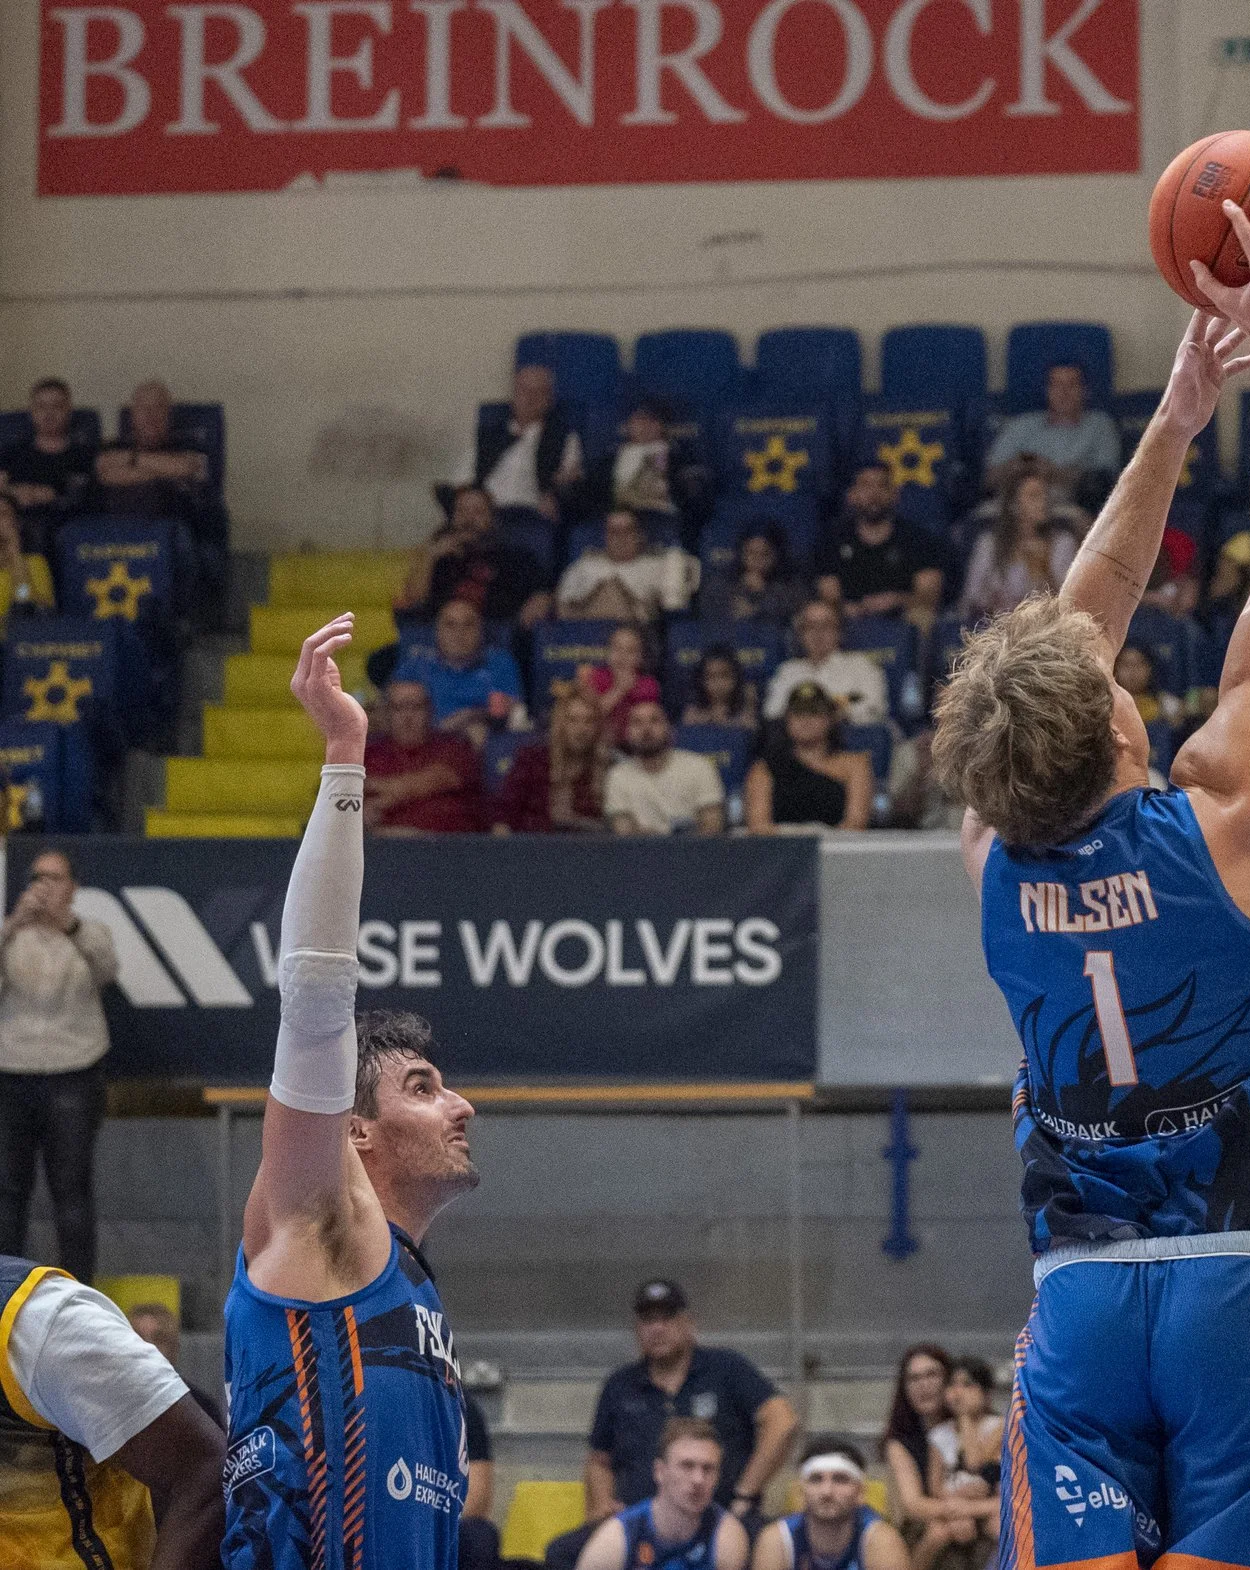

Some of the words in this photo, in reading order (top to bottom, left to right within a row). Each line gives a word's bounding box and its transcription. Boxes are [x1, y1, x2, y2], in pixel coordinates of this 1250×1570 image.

[46, 0, 1130, 138] BREINROCK
[459, 917, 782, 987] WOLVES
[1019, 870, 1159, 933] NILSEN
[1083, 950, 1139, 1087] 1
